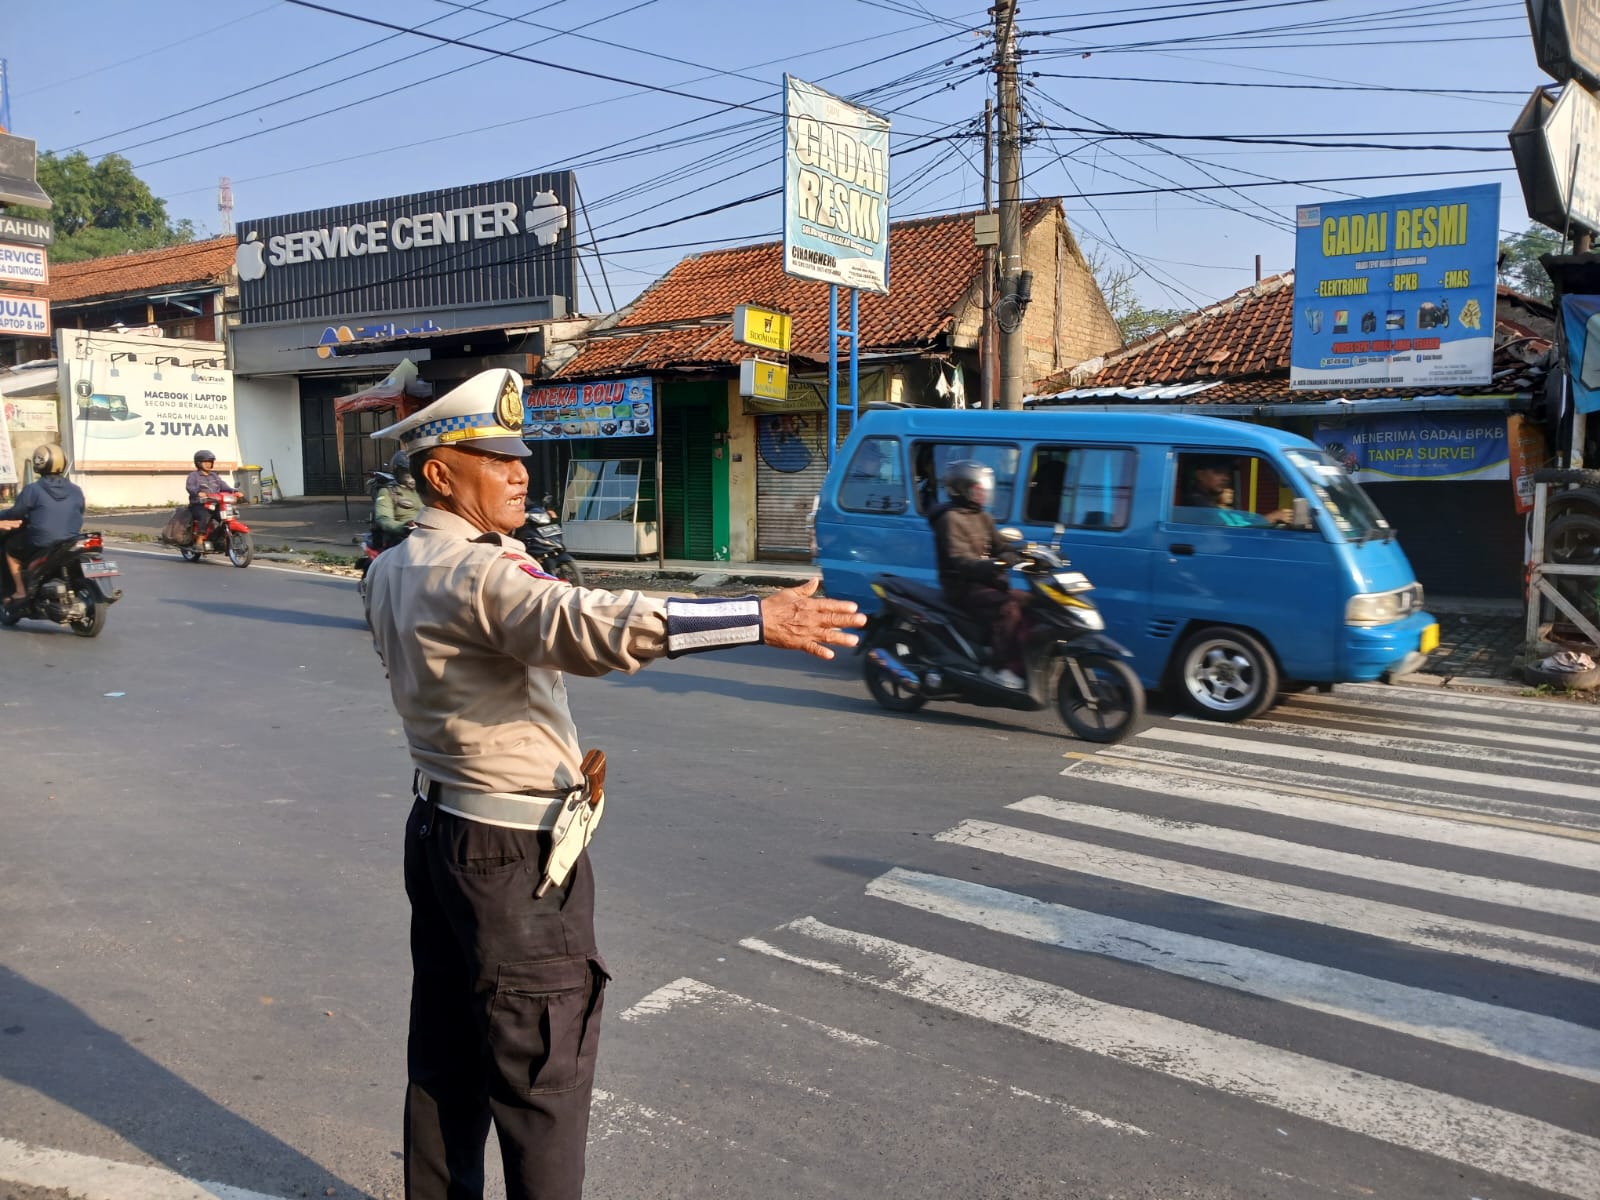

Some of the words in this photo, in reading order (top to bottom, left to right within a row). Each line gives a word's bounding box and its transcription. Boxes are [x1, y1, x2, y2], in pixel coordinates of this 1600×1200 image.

[795, 113, 883, 195] GADAI
[798, 167, 881, 245] RESMI
[268, 220, 388, 267] SERVICE
[391, 201, 519, 251] CENTER
[1322, 211, 1388, 257] GADAI
[1394, 203, 1468, 251] RESMI
[1319, 277, 1369, 298] ELEKTRONIK
[1394, 272, 1419, 292] BPKB
[1444, 270, 1470, 289] EMAS
[0, 299, 42, 319] JUAL
[34, 321, 45, 331] HP
[144, 391, 189, 400] MACBOOK
[195, 393, 227, 402] LAPTOP
[526, 386, 578, 408] ANEKA
[582, 382, 625, 405] BOLU
[178, 402, 228, 410] BERKUALITAS
[144, 420, 155, 435] 2
[160, 421, 229, 437] JUTAAN
[1352, 430, 1417, 446] MENERIMA
[1419, 429, 1463, 443] GADAI
[1465, 427, 1505, 440] BPKB
[1368, 448, 1415, 462] TANPA
[1418, 446, 1476, 461] SURVEI
